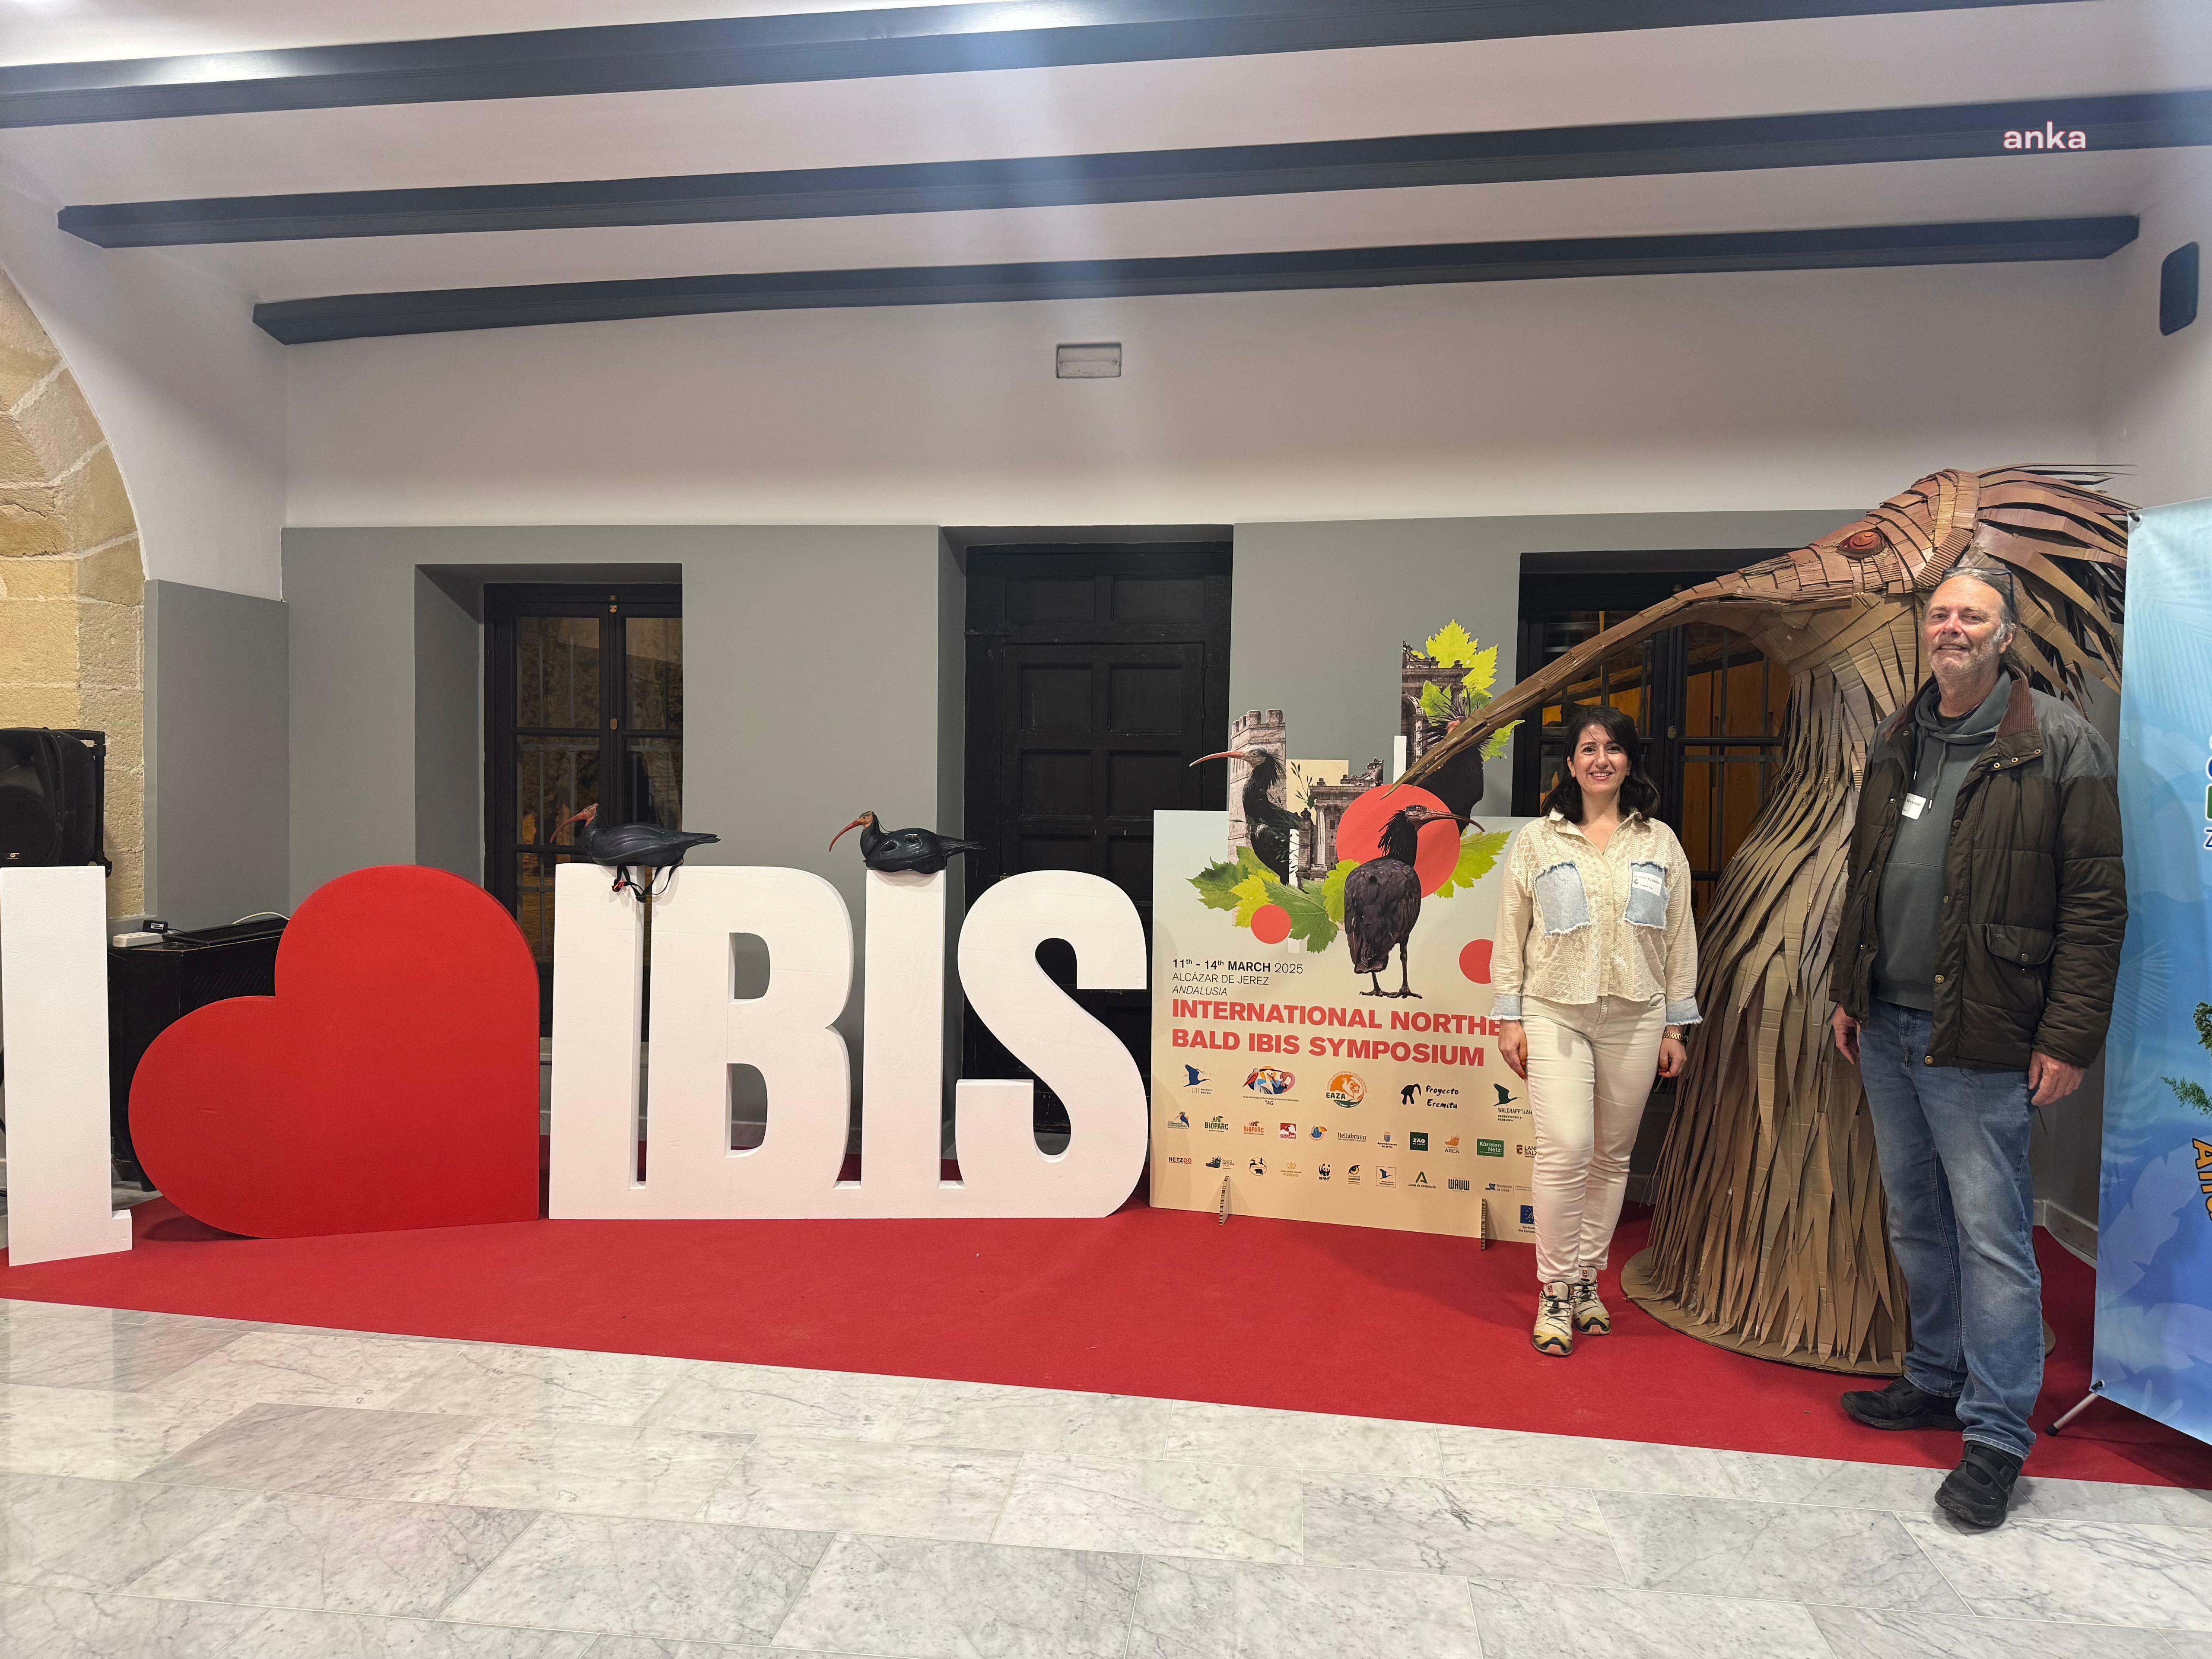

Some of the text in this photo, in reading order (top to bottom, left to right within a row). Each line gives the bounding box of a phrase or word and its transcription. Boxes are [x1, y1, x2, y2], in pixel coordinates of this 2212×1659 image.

[1228, 961, 1271, 972] MARCH
[1274, 963, 1303, 974] 2025
[1172, 972, 1269, 985] ALCÁZAR DE JEREZ
[1172, 985, 1227, 995] ANDALUSIA
[1172, 999, 1382, 1029] INTERNATIONAL
[1172, 1028, 1484, 1067] BALD IBIS SYMPOSIUM
[0, 863, 1148, 1266] I IBIS
[1426, 1085, 1459, 1096] Proyecto
[1427, 1099, 1458, 1109] Eremita
[1337, 1132, 1366, 1140] Hellabrunn
